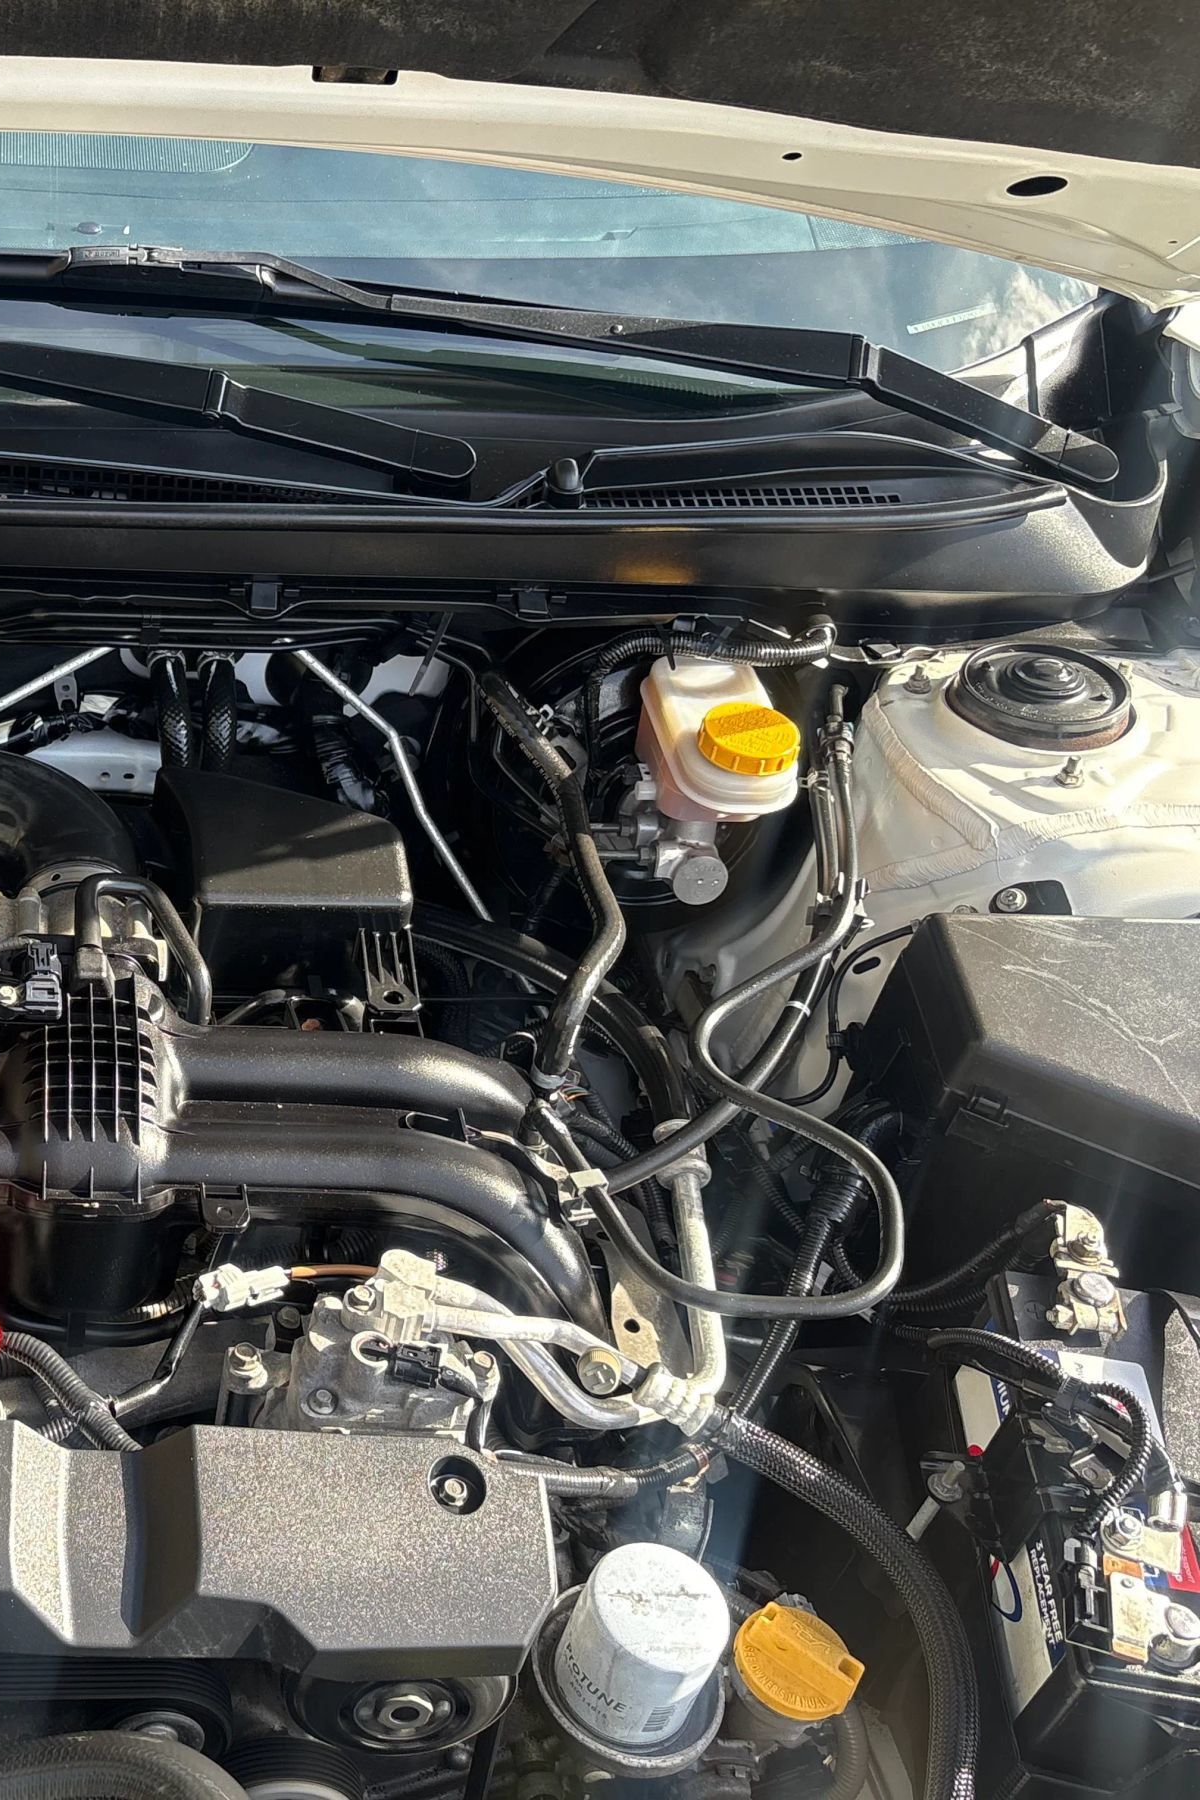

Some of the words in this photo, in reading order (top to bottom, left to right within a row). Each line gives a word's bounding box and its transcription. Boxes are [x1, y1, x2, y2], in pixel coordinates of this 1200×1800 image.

[1035, 1539, 1044, 1551] 3
[1039, 1551, 1053, 1597] YEAR
[1047, 1598, 1064, 1643] FREE
[743, 1645, 757, 1664] SEE
[787, 1692, 828, 1710] MANUAL
